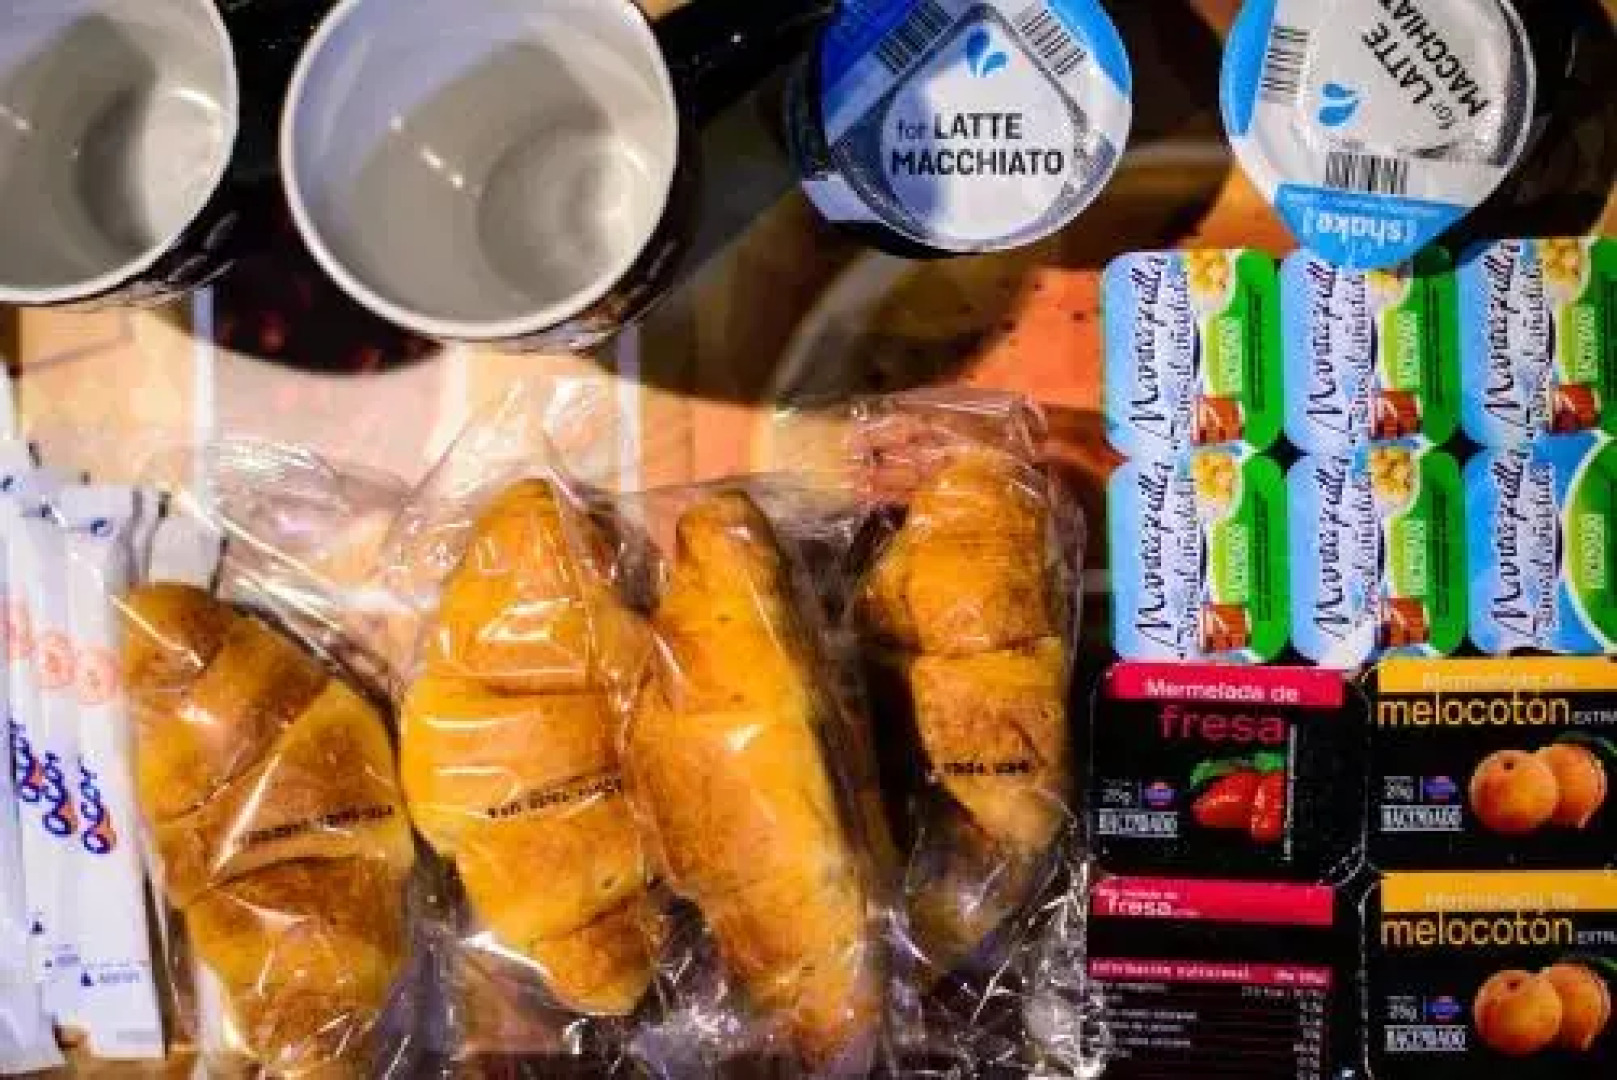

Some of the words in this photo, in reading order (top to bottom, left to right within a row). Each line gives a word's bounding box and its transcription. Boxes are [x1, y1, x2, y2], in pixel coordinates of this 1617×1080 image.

[1362, 22, 1433, 104] LATTE
[897, 119, 928, 142] for
[934, 112, 1022, 140] LATTE
[891, 149, 1065, 176] MACCHIATO
[1143, 678, 1265, 700] Mermelada
[1271, 684, 1298, 703] de
[1158, 704, 1283, 744] fresa
